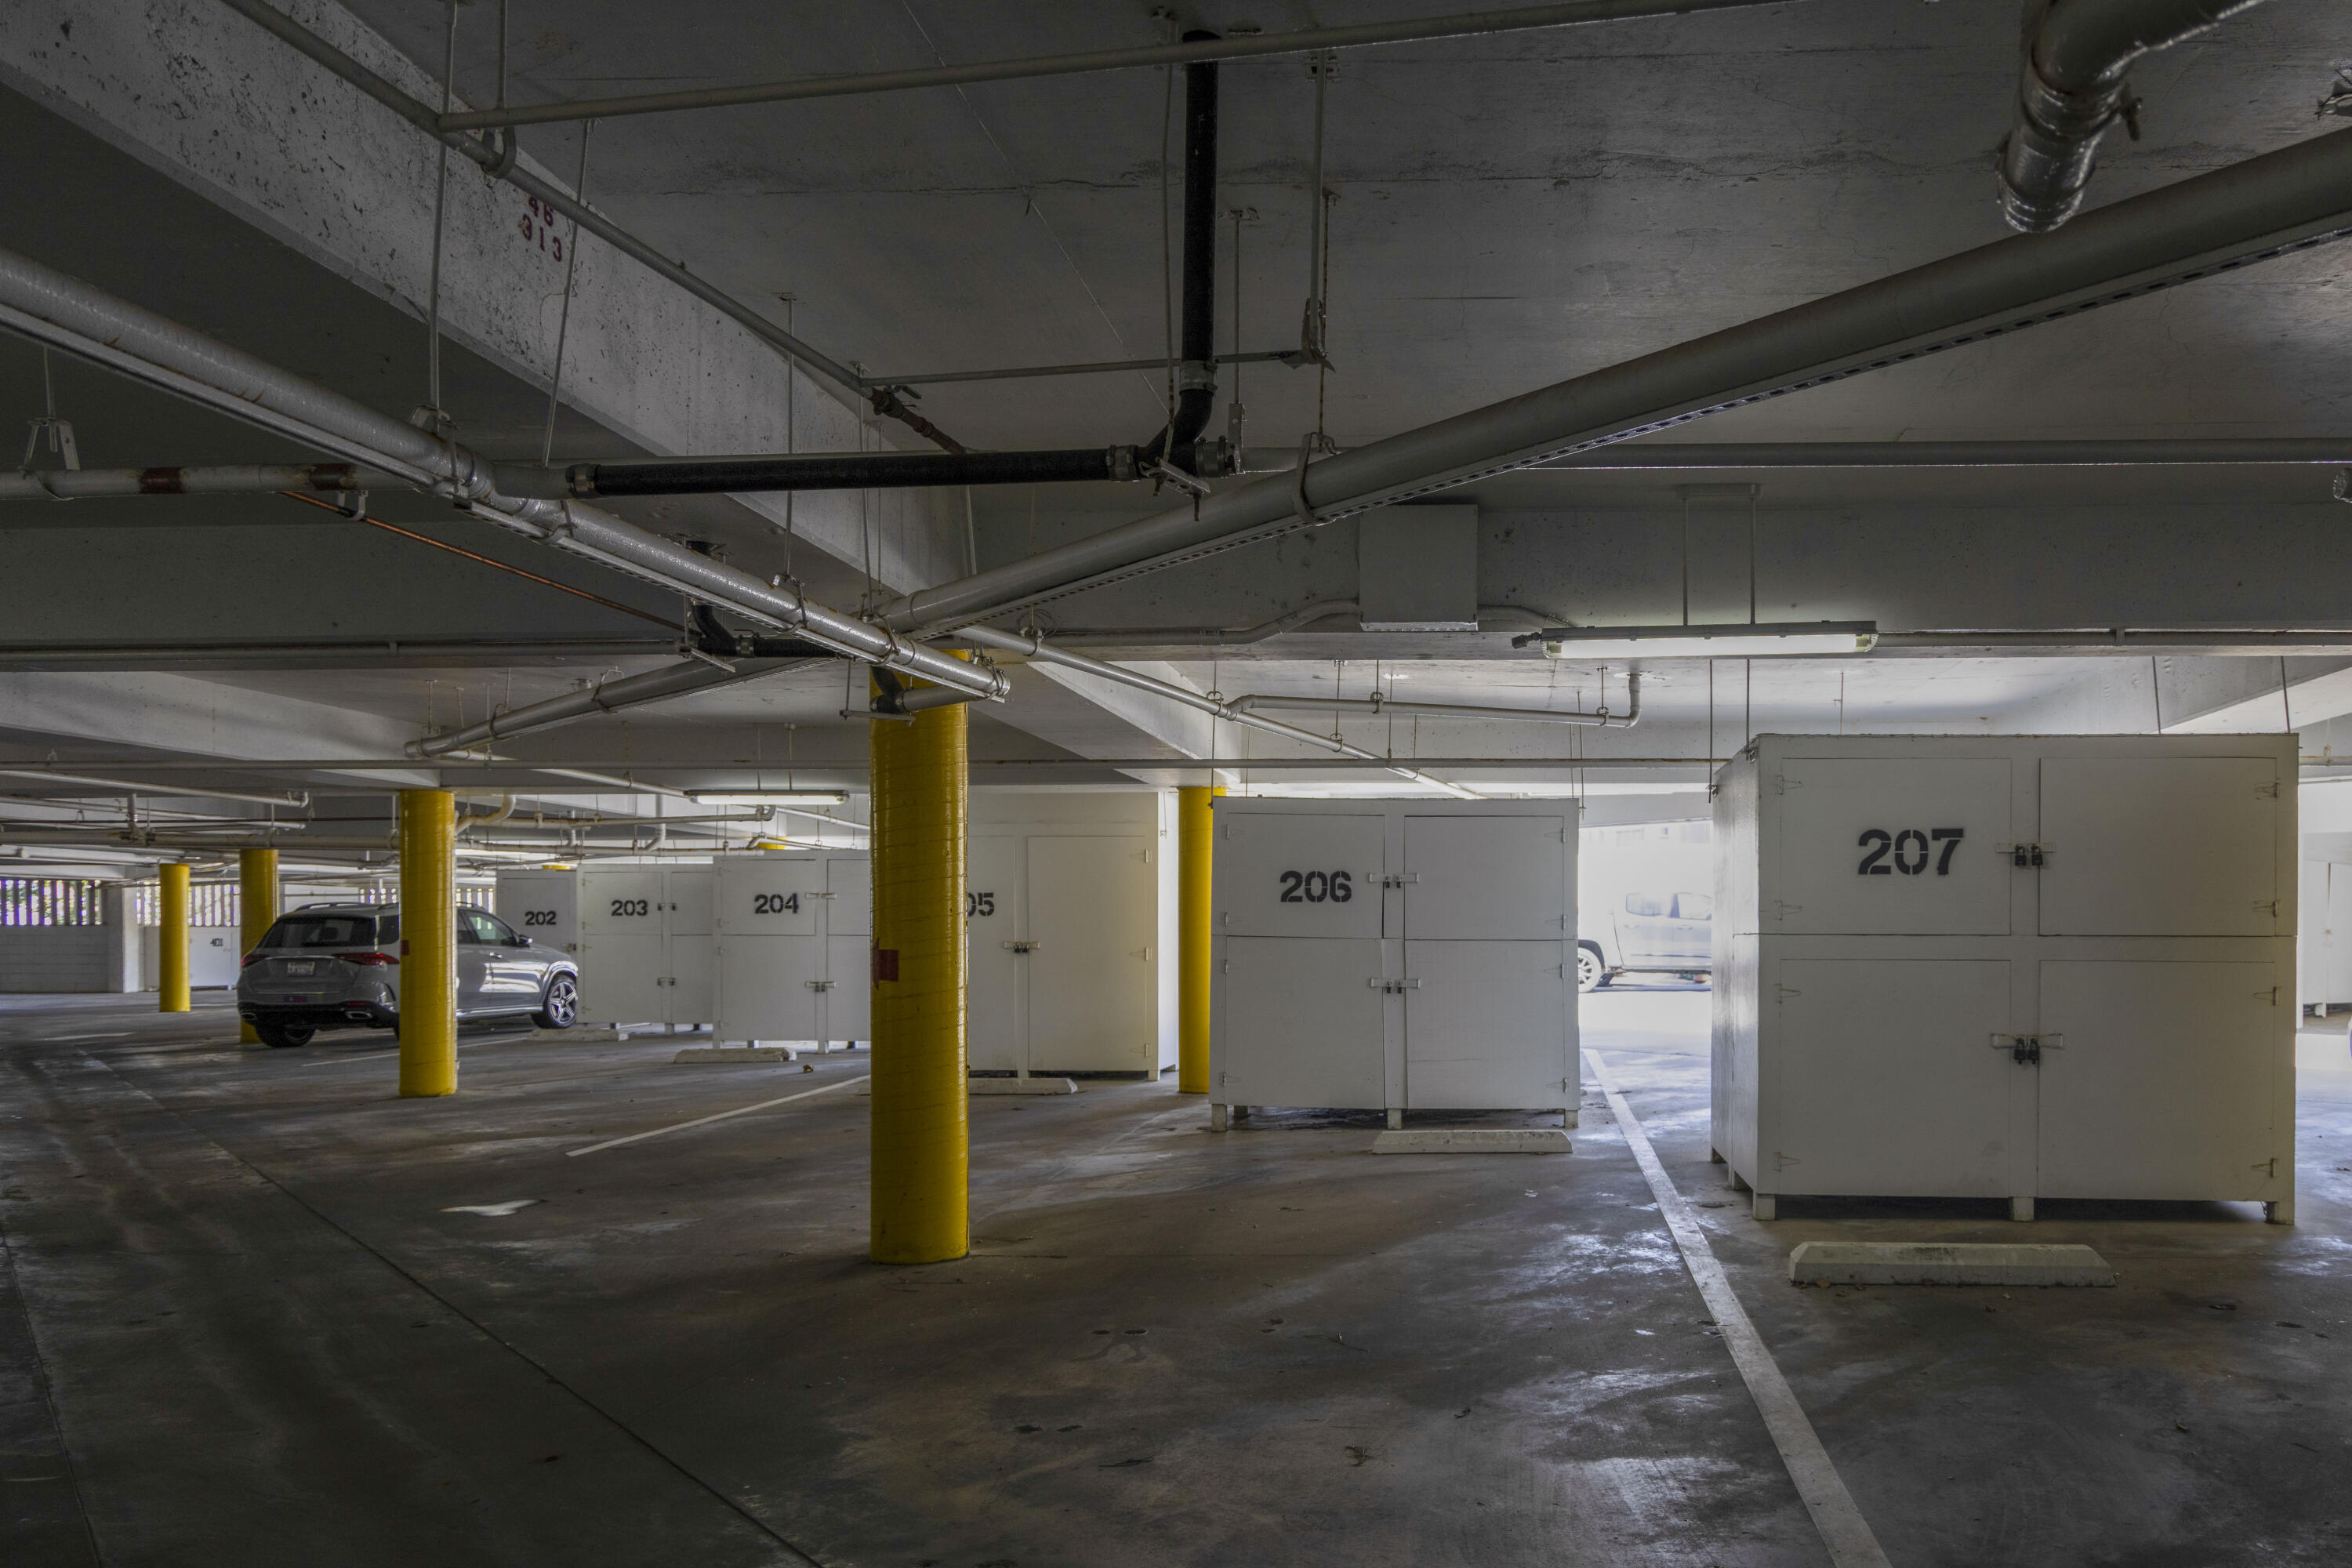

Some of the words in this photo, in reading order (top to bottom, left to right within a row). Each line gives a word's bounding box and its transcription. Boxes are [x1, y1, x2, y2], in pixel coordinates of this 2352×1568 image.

[521, 213, 562, 263] 313
[1858, 828, 1964, 877] 207
[1279, 870, 1352, 903] 206
[612, 899, 648, 916] 203
[754, 893, 799, 914] 204
[967, 892, 995, 917] 05
[524, 910, 557, 926] 202
